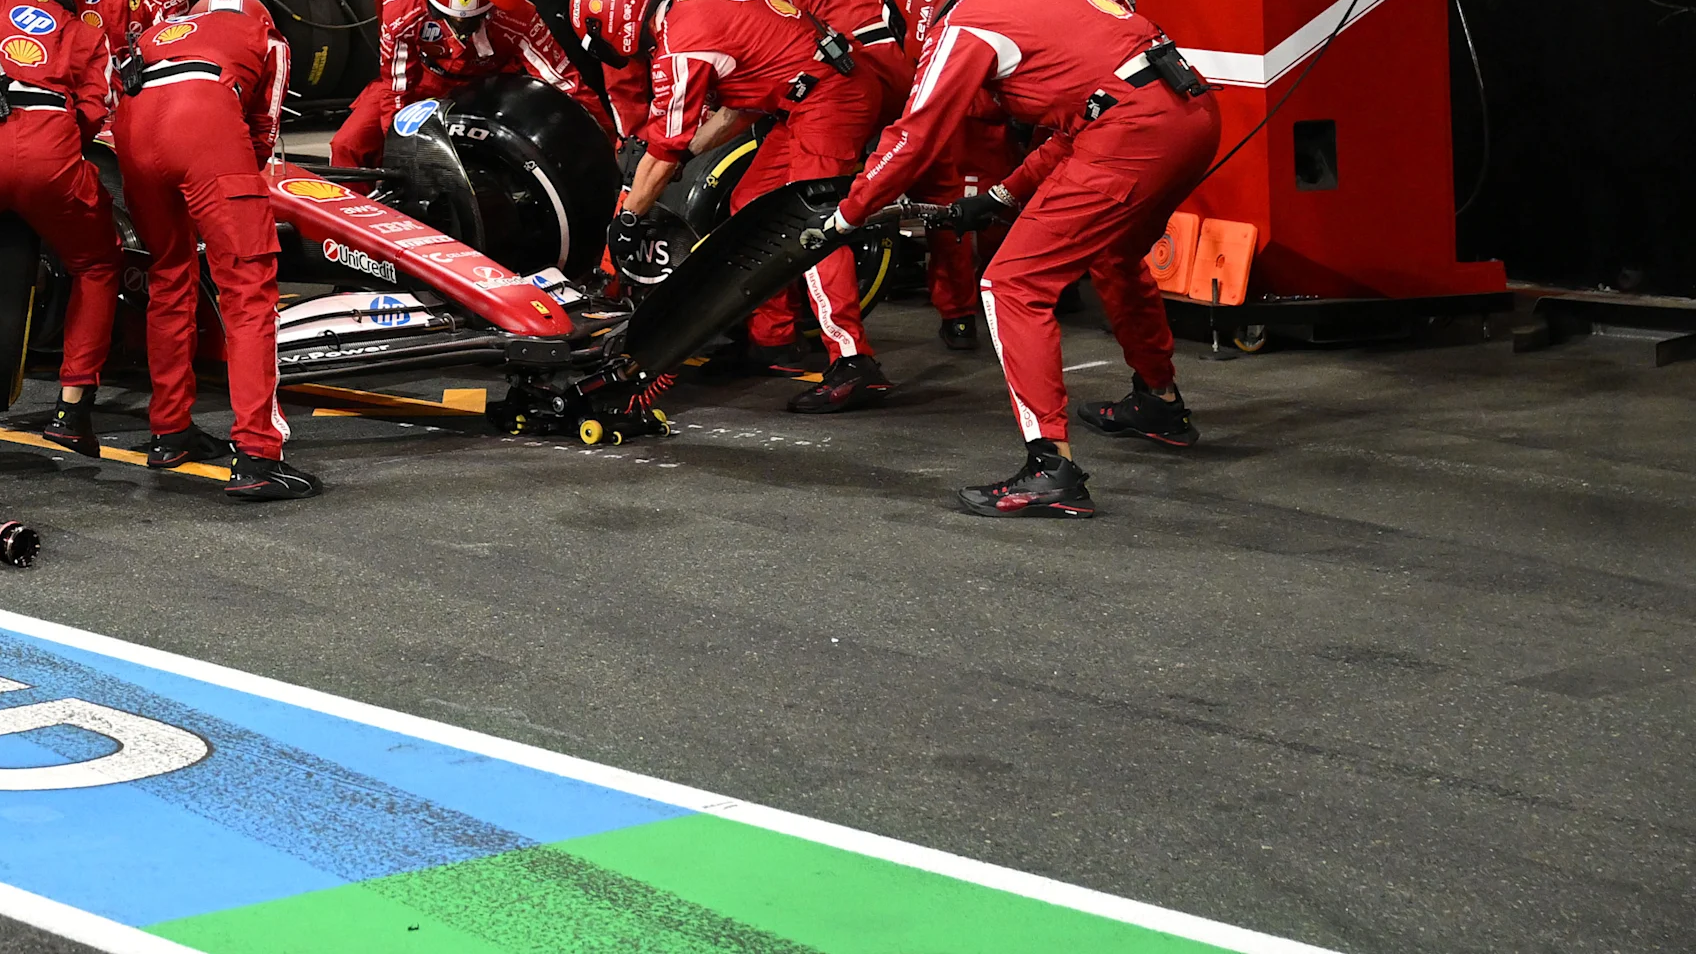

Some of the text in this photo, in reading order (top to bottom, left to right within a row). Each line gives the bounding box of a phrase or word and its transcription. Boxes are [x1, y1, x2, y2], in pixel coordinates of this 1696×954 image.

[11, 6, 53, 35] hp
[421, 22, 441, 42] hp
[916, 6, 931, 42] CEVA
[623, 22, 632, 53] CEVA
[395, 101, 437, 136] hp
[446, 122, 489, 141] RO
[865, 129, 909, 182] RICHARD MILLE
[369, 220, 425, 234] IBM
[338, 245, 397, 284] UniCredit
[634, 240, 670, 266] WS
